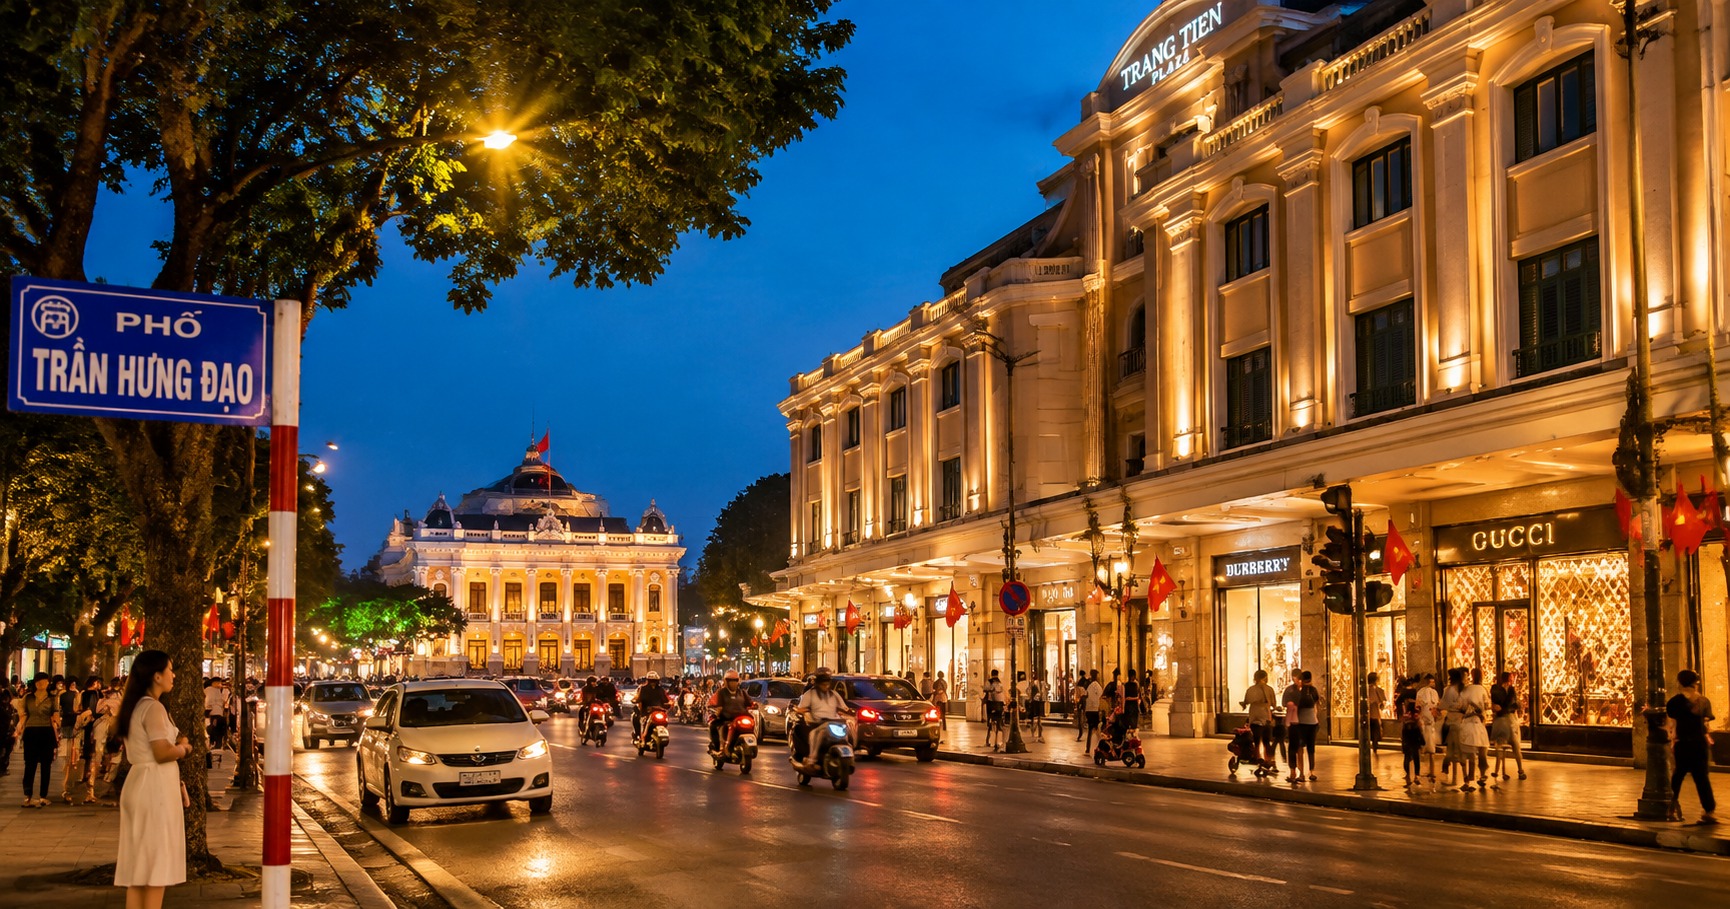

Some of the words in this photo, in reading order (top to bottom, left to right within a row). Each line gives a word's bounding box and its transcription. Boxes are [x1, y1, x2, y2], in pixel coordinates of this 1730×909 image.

[1120, 35, 1176, 91] TRANG
[1179, 1, 1222, 50] TIEN
[116, 310, 202, 338] PHỐ
[32, 337, 108, 395] TRẦN
[117, 352, 192, 400] HƯNG
[200, 361, 253, 413] ĐẠO
